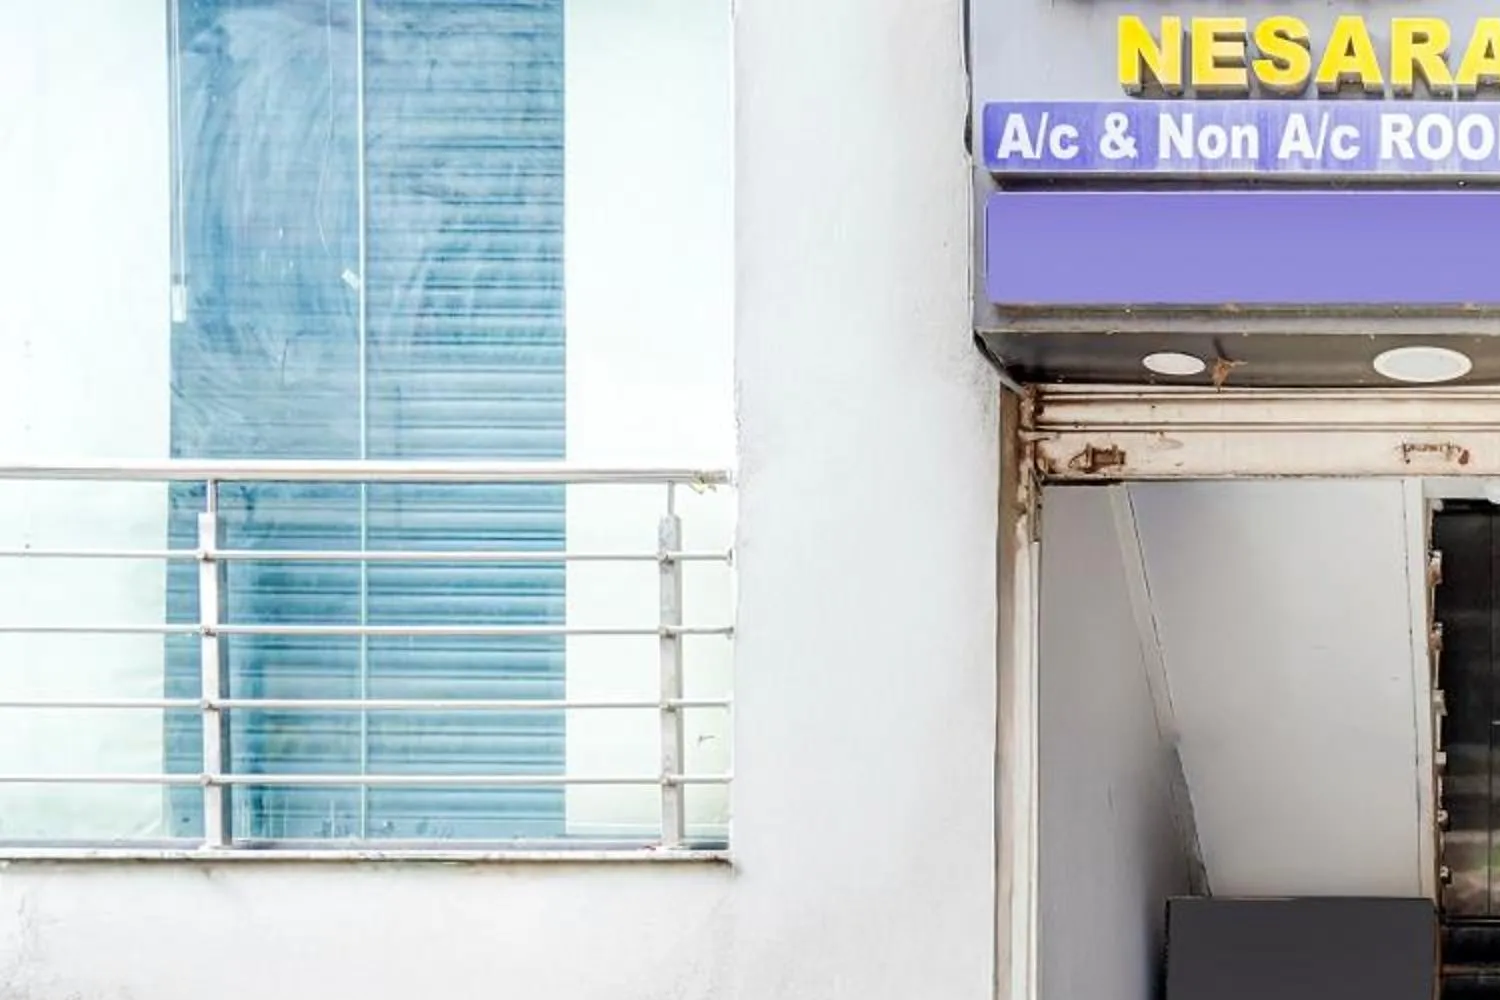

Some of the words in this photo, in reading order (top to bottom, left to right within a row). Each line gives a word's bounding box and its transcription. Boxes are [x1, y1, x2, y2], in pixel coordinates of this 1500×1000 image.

[998, 114, 1079, 159] A/c
[1099, 113, 1138, 159] &
[1159, 113, 1259, 159] Non
[1278, 113, 1360, 160] A/c
